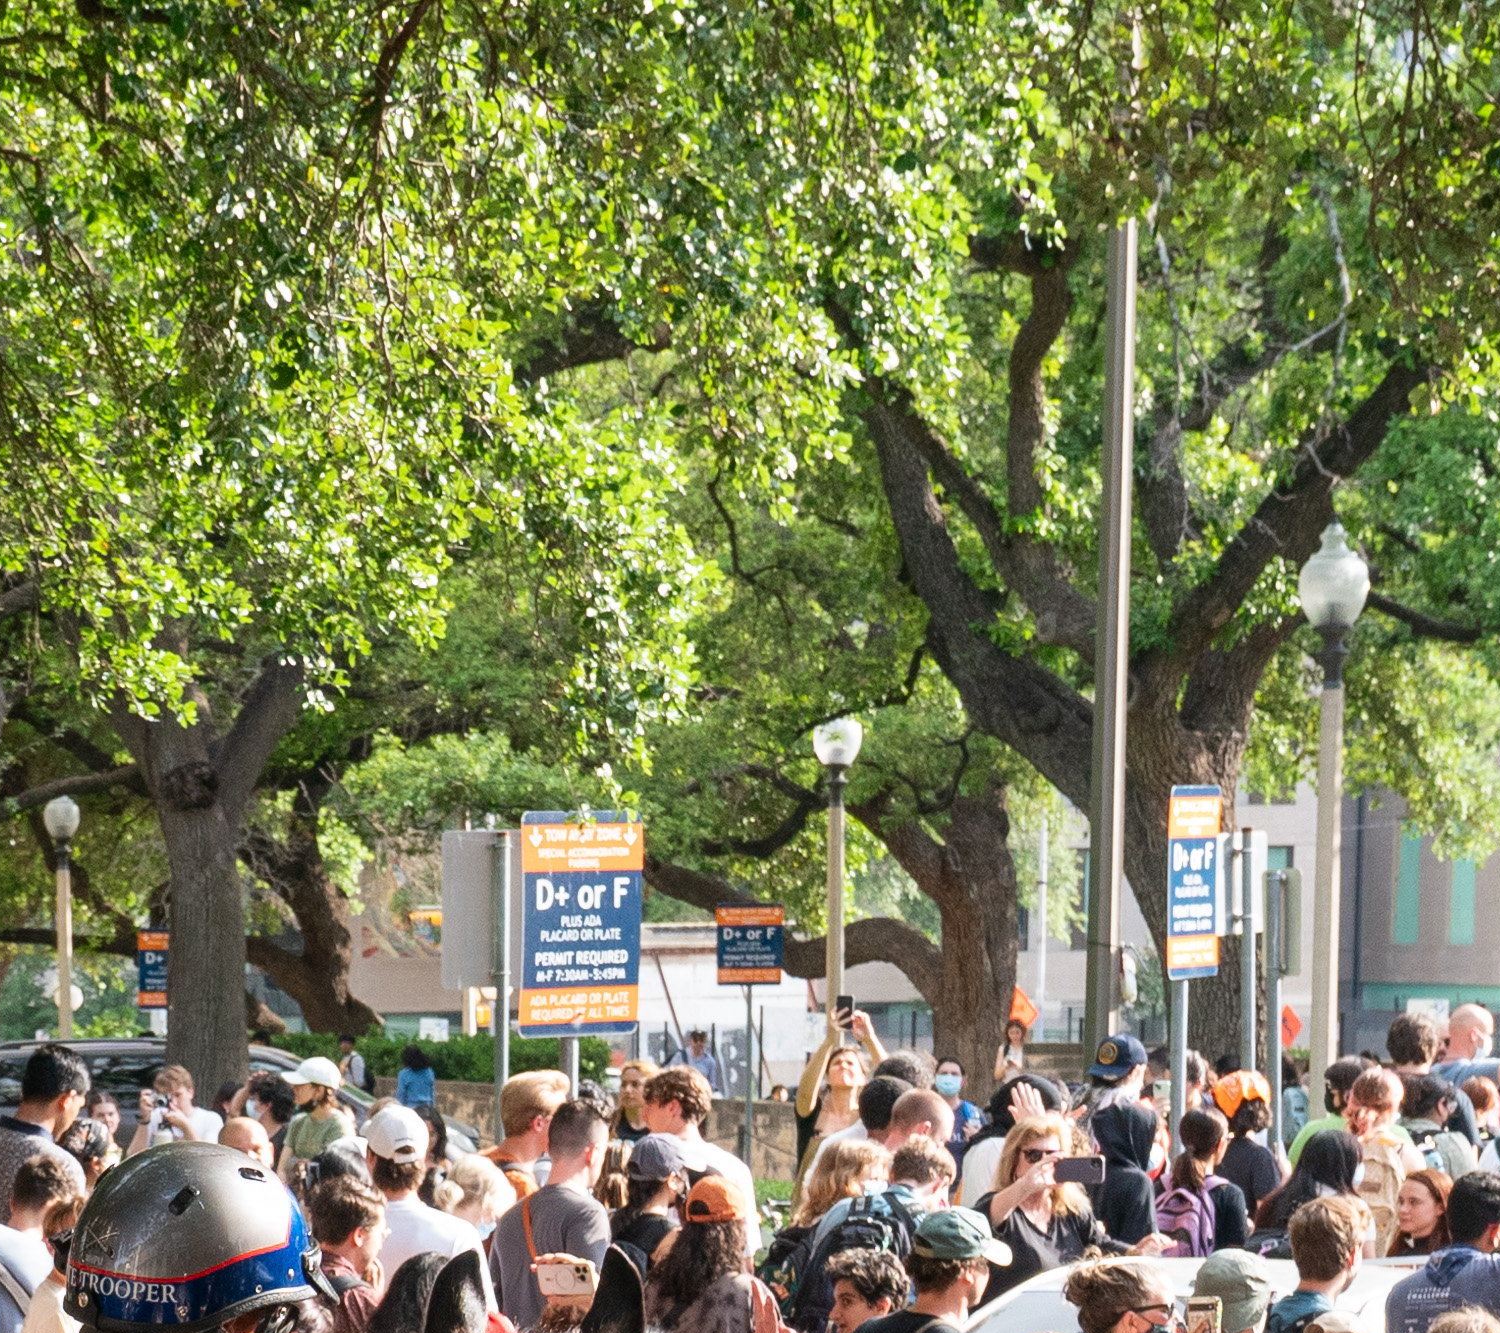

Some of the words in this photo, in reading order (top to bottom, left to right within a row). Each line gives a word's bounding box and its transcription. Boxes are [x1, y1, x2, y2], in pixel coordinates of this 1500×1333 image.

[544, 828, 567, 842] TOW
[597, 827, 623, 841] ZONE
[536, 878, 570, 911] D+
[577, 885, 606, 910] or
[613, 877, 630, 909] F
[560, 915, 582, 927] PLUS
[584, 914, 602, 926] ADA
[540, 929, 579, 942] PLACARD
[580, 929, 594, 941] OR
[594, 928, 622, 941] PLATE
[723, 927, 742, 940] D+
[746, 930, 762, 940] or
[535, 952, 574, 967] PERMIT
[576, 950, 628, 966] REQUIRED
[536, 970, 553, 982] M-F
[530, 995, 548, 1007] ADA
[550, 993, 588, 1006] PLACARD
[589, 992, 602, 1004] OR
[603, 991, 629, 1004] PLATE
[587, 1007, 603, 1018] ALL
[606, 1005, 630, 1018] TIMES
[79, 1271, 178, 1303] TROOPER
